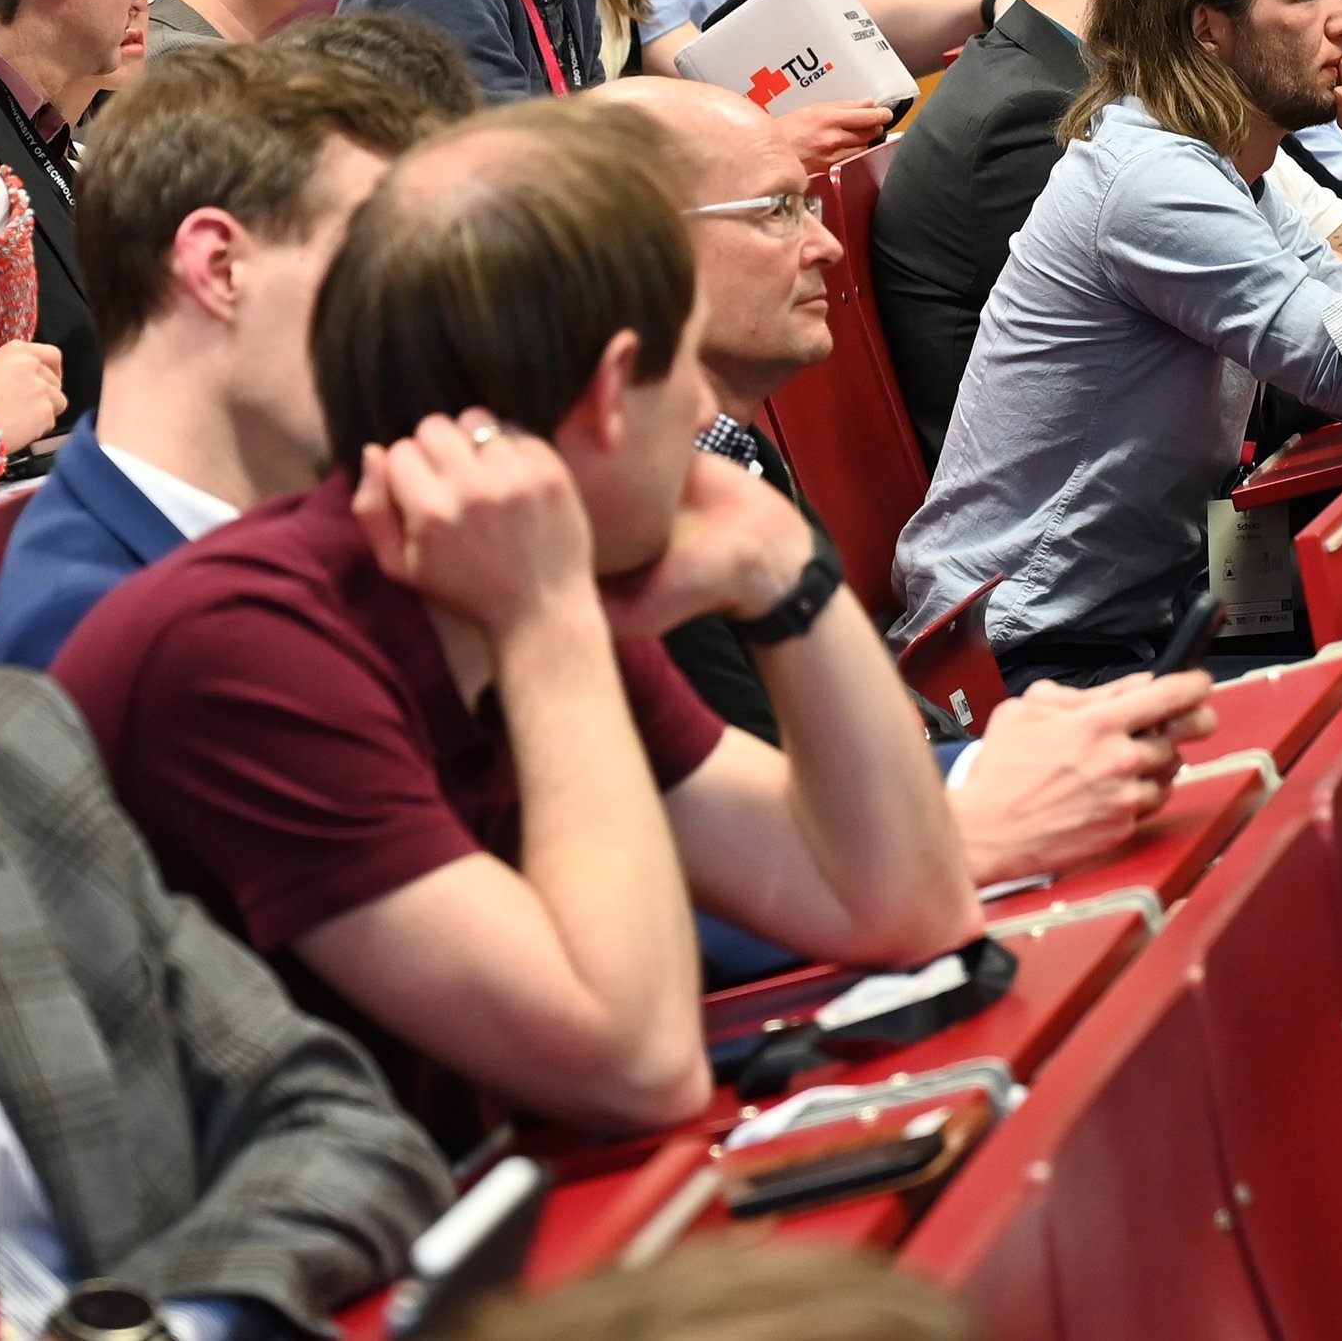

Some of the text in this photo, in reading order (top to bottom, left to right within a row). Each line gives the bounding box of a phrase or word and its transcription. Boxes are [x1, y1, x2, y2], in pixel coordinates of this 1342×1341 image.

[781, 47, 819, 81] TU
[800, 66, 827, 88] Graz
[34, 146, 47, 160] OF
